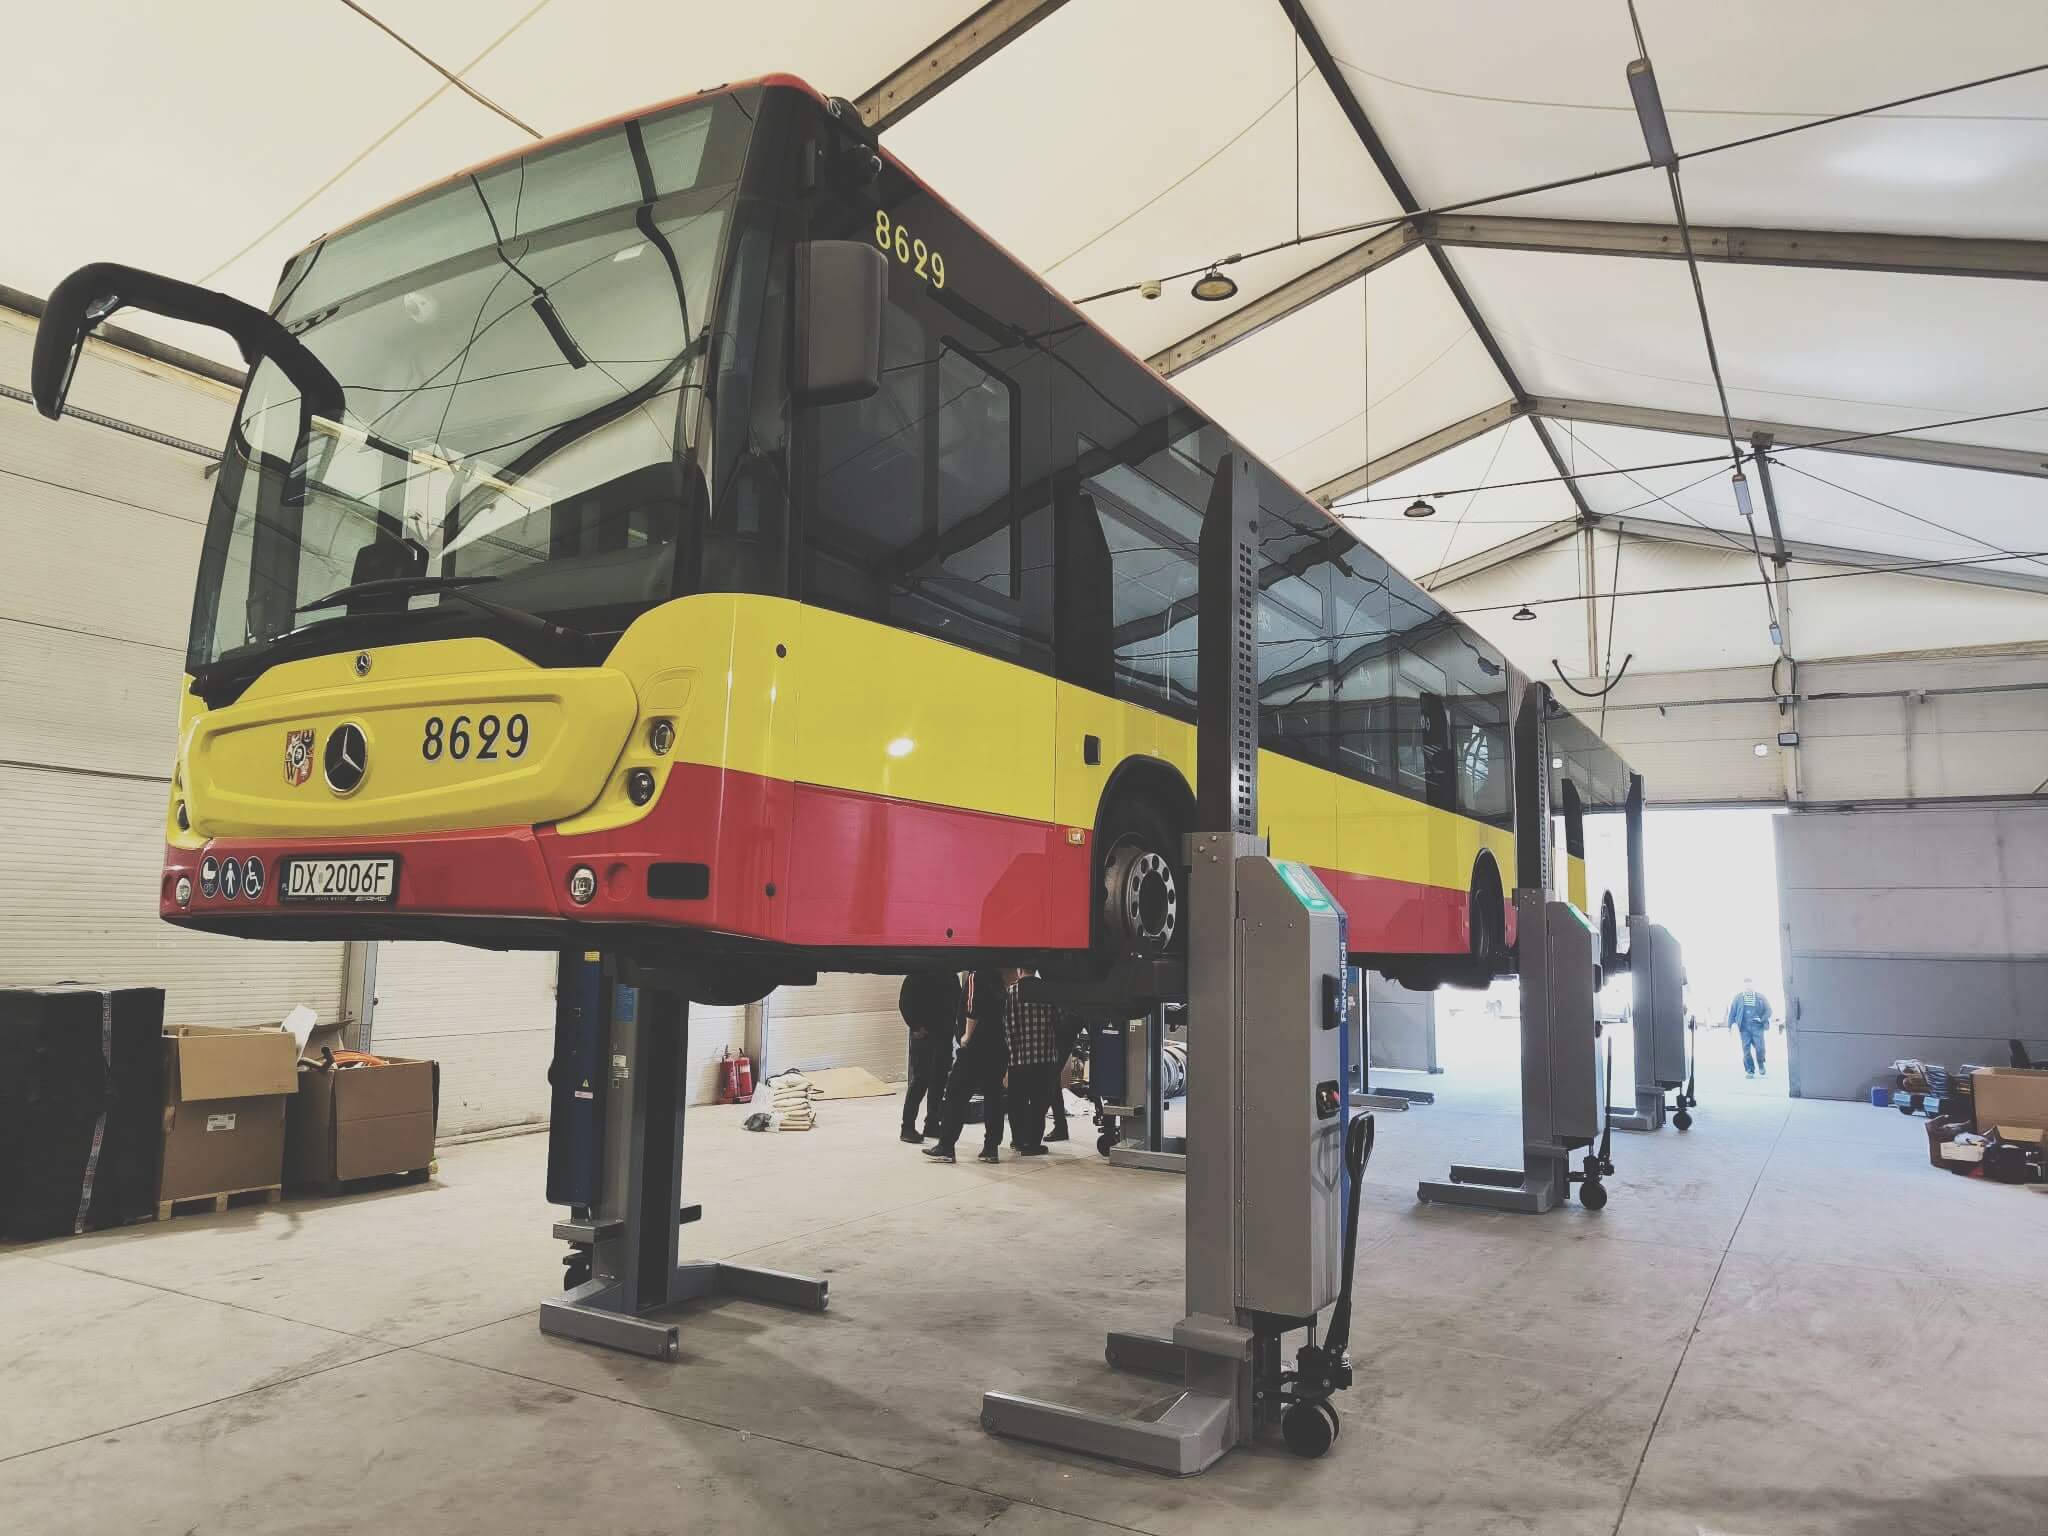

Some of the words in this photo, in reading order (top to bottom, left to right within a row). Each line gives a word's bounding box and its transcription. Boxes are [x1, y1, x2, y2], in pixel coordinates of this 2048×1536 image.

[876, 210, 945, 288] 8629
[422, 713, 529, 760] 8629
[292, 863, 318, 893] DX
[323, 862, 389, 893] 2006F
[1340, 941, 1348, 1022] Ravaglioli
